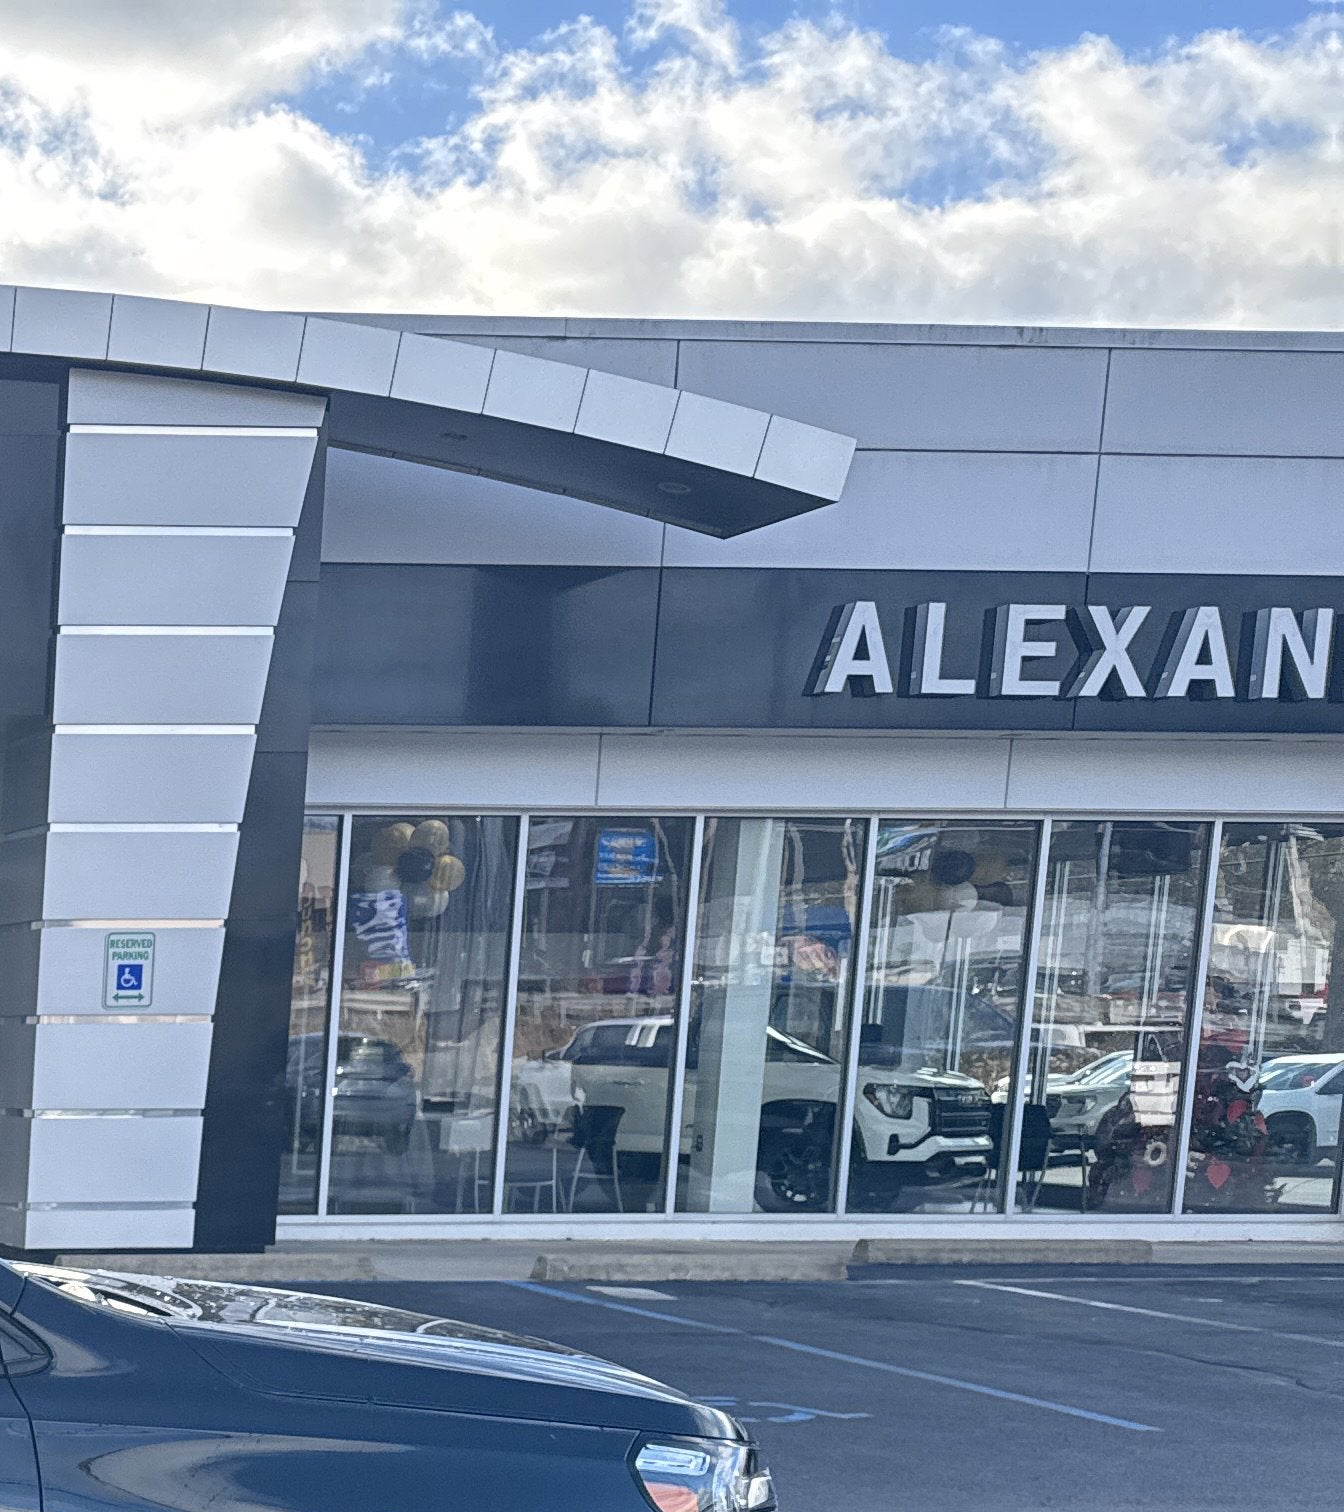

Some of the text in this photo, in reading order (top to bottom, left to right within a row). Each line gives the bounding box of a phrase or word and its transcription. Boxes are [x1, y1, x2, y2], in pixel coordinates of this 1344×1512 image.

[816, 600, 1335, 699] ALEXAN
[109, 939, 153, 949] RESERVED
[112, 951, 149, 961] PARKING
